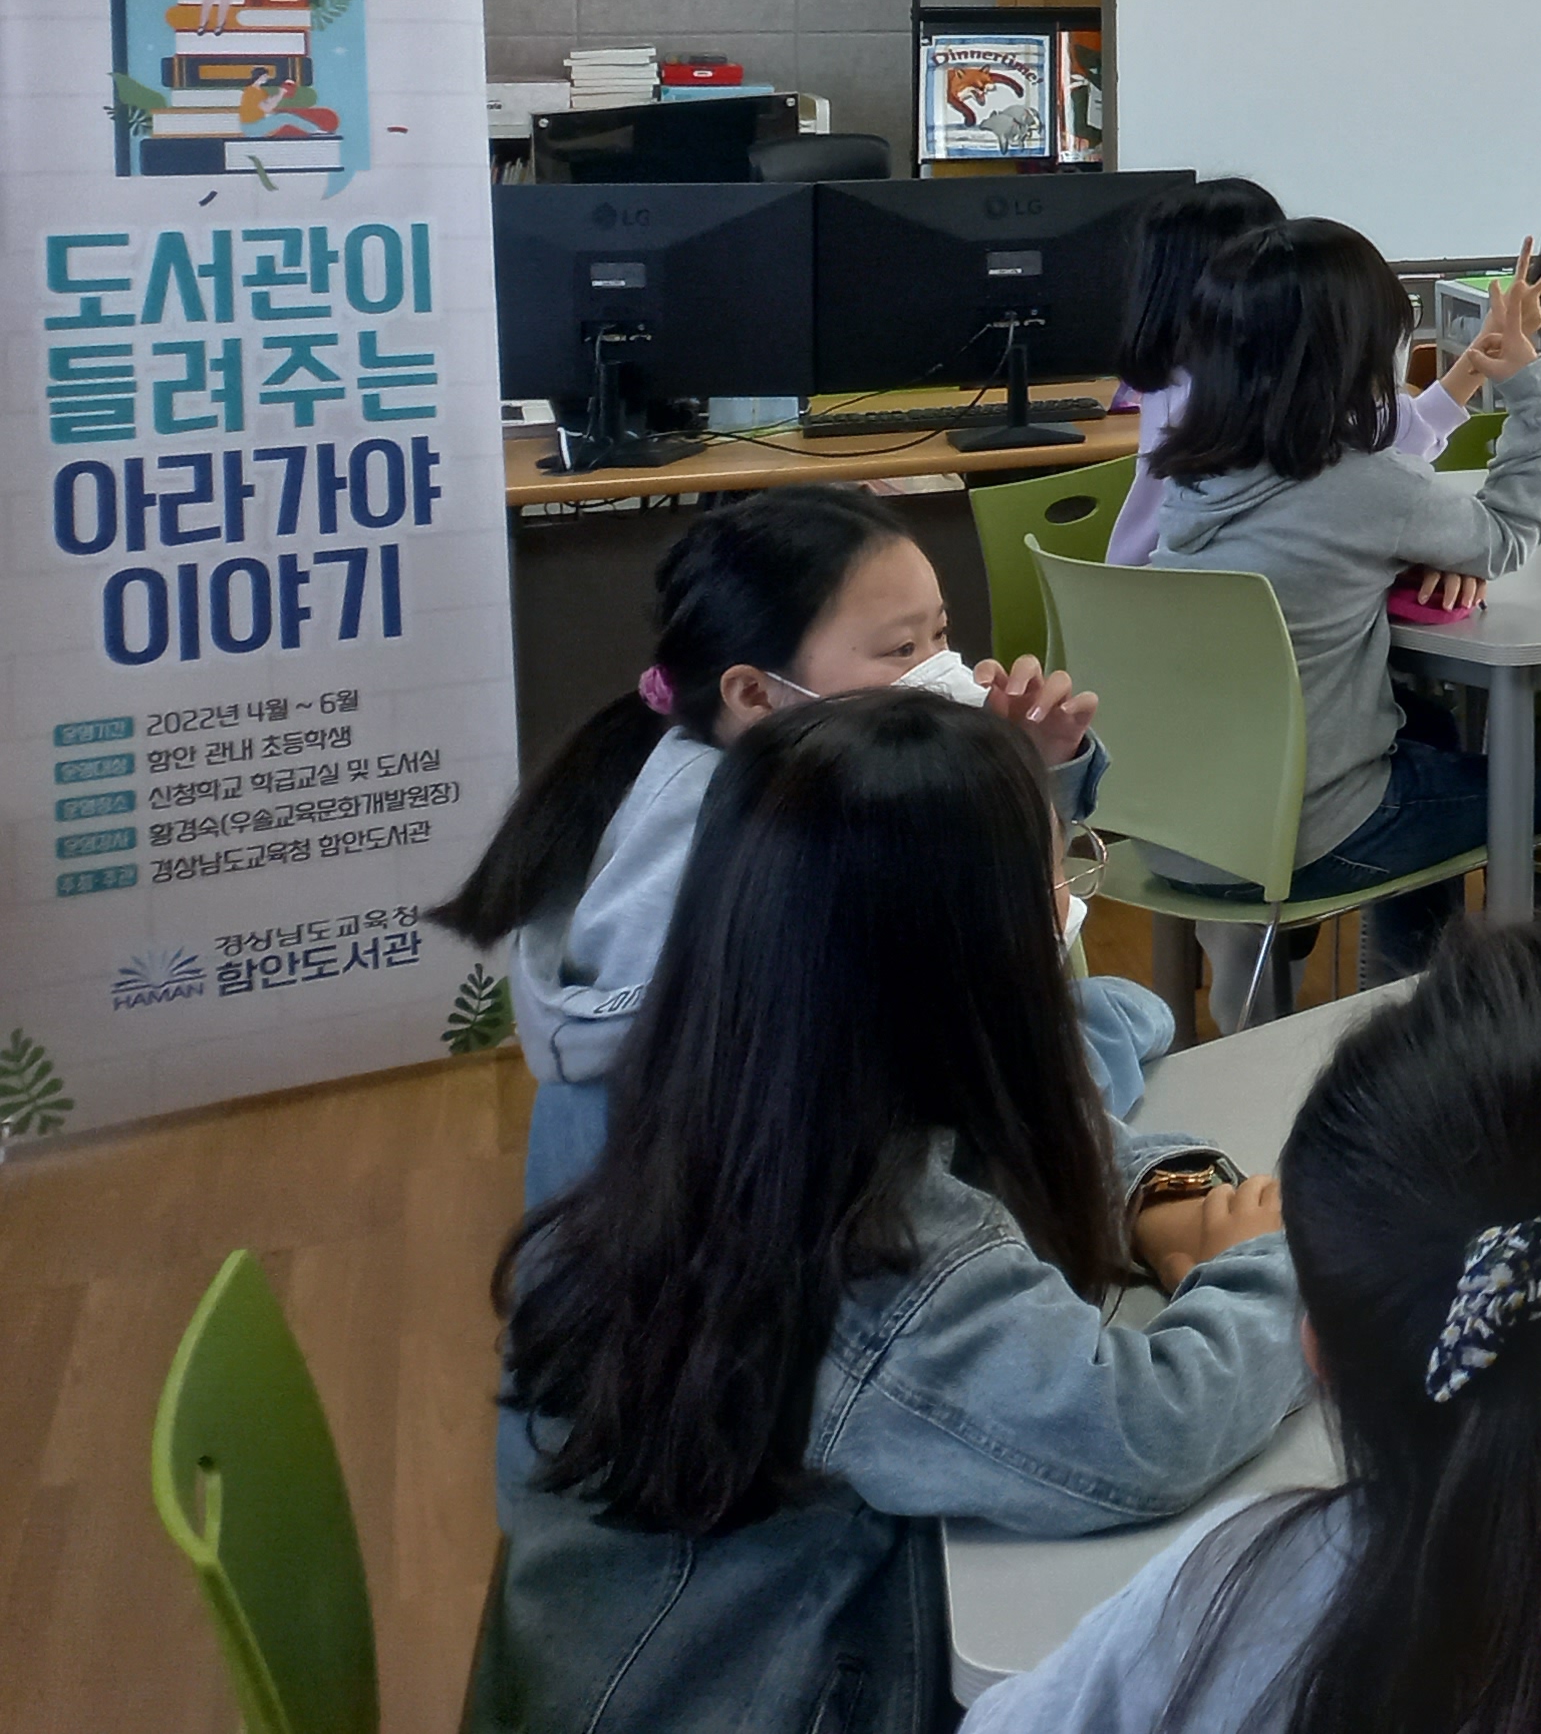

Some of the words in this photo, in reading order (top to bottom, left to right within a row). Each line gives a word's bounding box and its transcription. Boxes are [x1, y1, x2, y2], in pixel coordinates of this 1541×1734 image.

[931, 49, 1044, 85] Dinnertime!
[1015, 199, 1042, 215] LG
[44, 222, 433, 331] 도서관이
[46, 330, 439, 445] 들려주는
[53, 435, 442, 556] 아라가야
[102, 543, 403, 666] 이야기
[146, 703, 240, 737] 2022년
[247, 698, 289, 722] 4월
[319, 689, 359, 714] 6월
[147, 745, 197, 774] 함안
[205, 737, 254, 766] 관내
[261, 725, 352, 759] 초등학생
[148, 775, 243, 810] 신청학교
[250, 762, 339, 794] 학급교실
[347, 758, 369, 782] 및
[377, 748, 441, 778] 도서실
[150, 837, 311, 884] 경상남도교육청
[318, 819, 432, 858] 함안도서관
[215, 930, 422, 997] 함안도서관
[113, 983, 204, 1011] HAMAN
